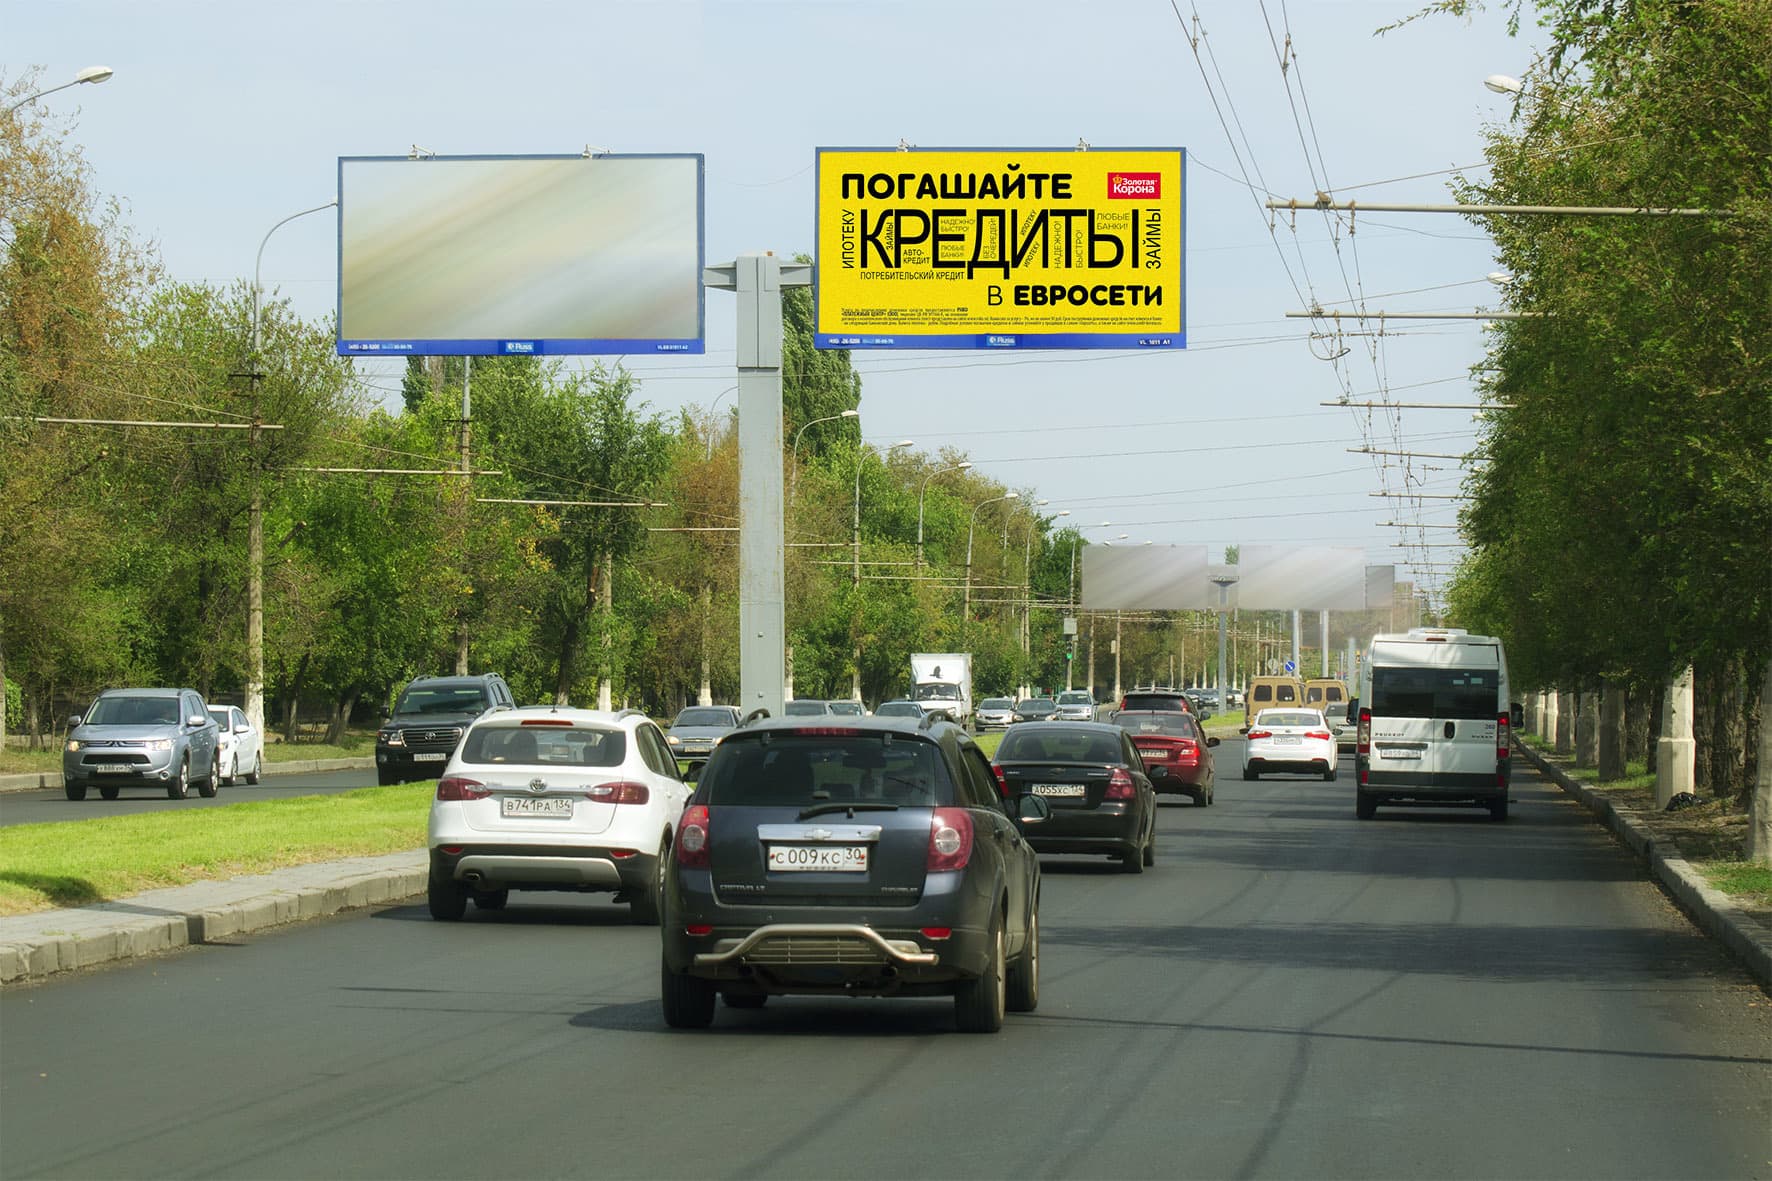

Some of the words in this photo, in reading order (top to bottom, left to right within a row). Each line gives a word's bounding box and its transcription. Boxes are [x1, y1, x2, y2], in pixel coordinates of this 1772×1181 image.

[841, 163, 1073, 200] ПОГАШАЙТЕ
[1122, 177, 1155, 186] Золотая
[1113, 184, 1155, 195] Корона
[1096, 212, 1130, 221] ЛЮБЫЕ
[842, 209, 855, 269] ИПОТЕКУ
[860, 208, 1139, 280] КРЕДИТЫ
[1143, 208, 1161, 269] ЗАЙМЫ
[903, 249, 925, 257] АВТО-
[903, 257, 930, 265] КРЕДИТ
[860, 270, 935, 281] ПОТРЕБИТЕЛЬСКИЙ
[936, 271, 965, 281] КРЕДИТ
[987, 285, 1003, 306] В
[1014, 285, 1163, 306] ЕВРОСЕТИ
[845, 848, 861, 861] 30
